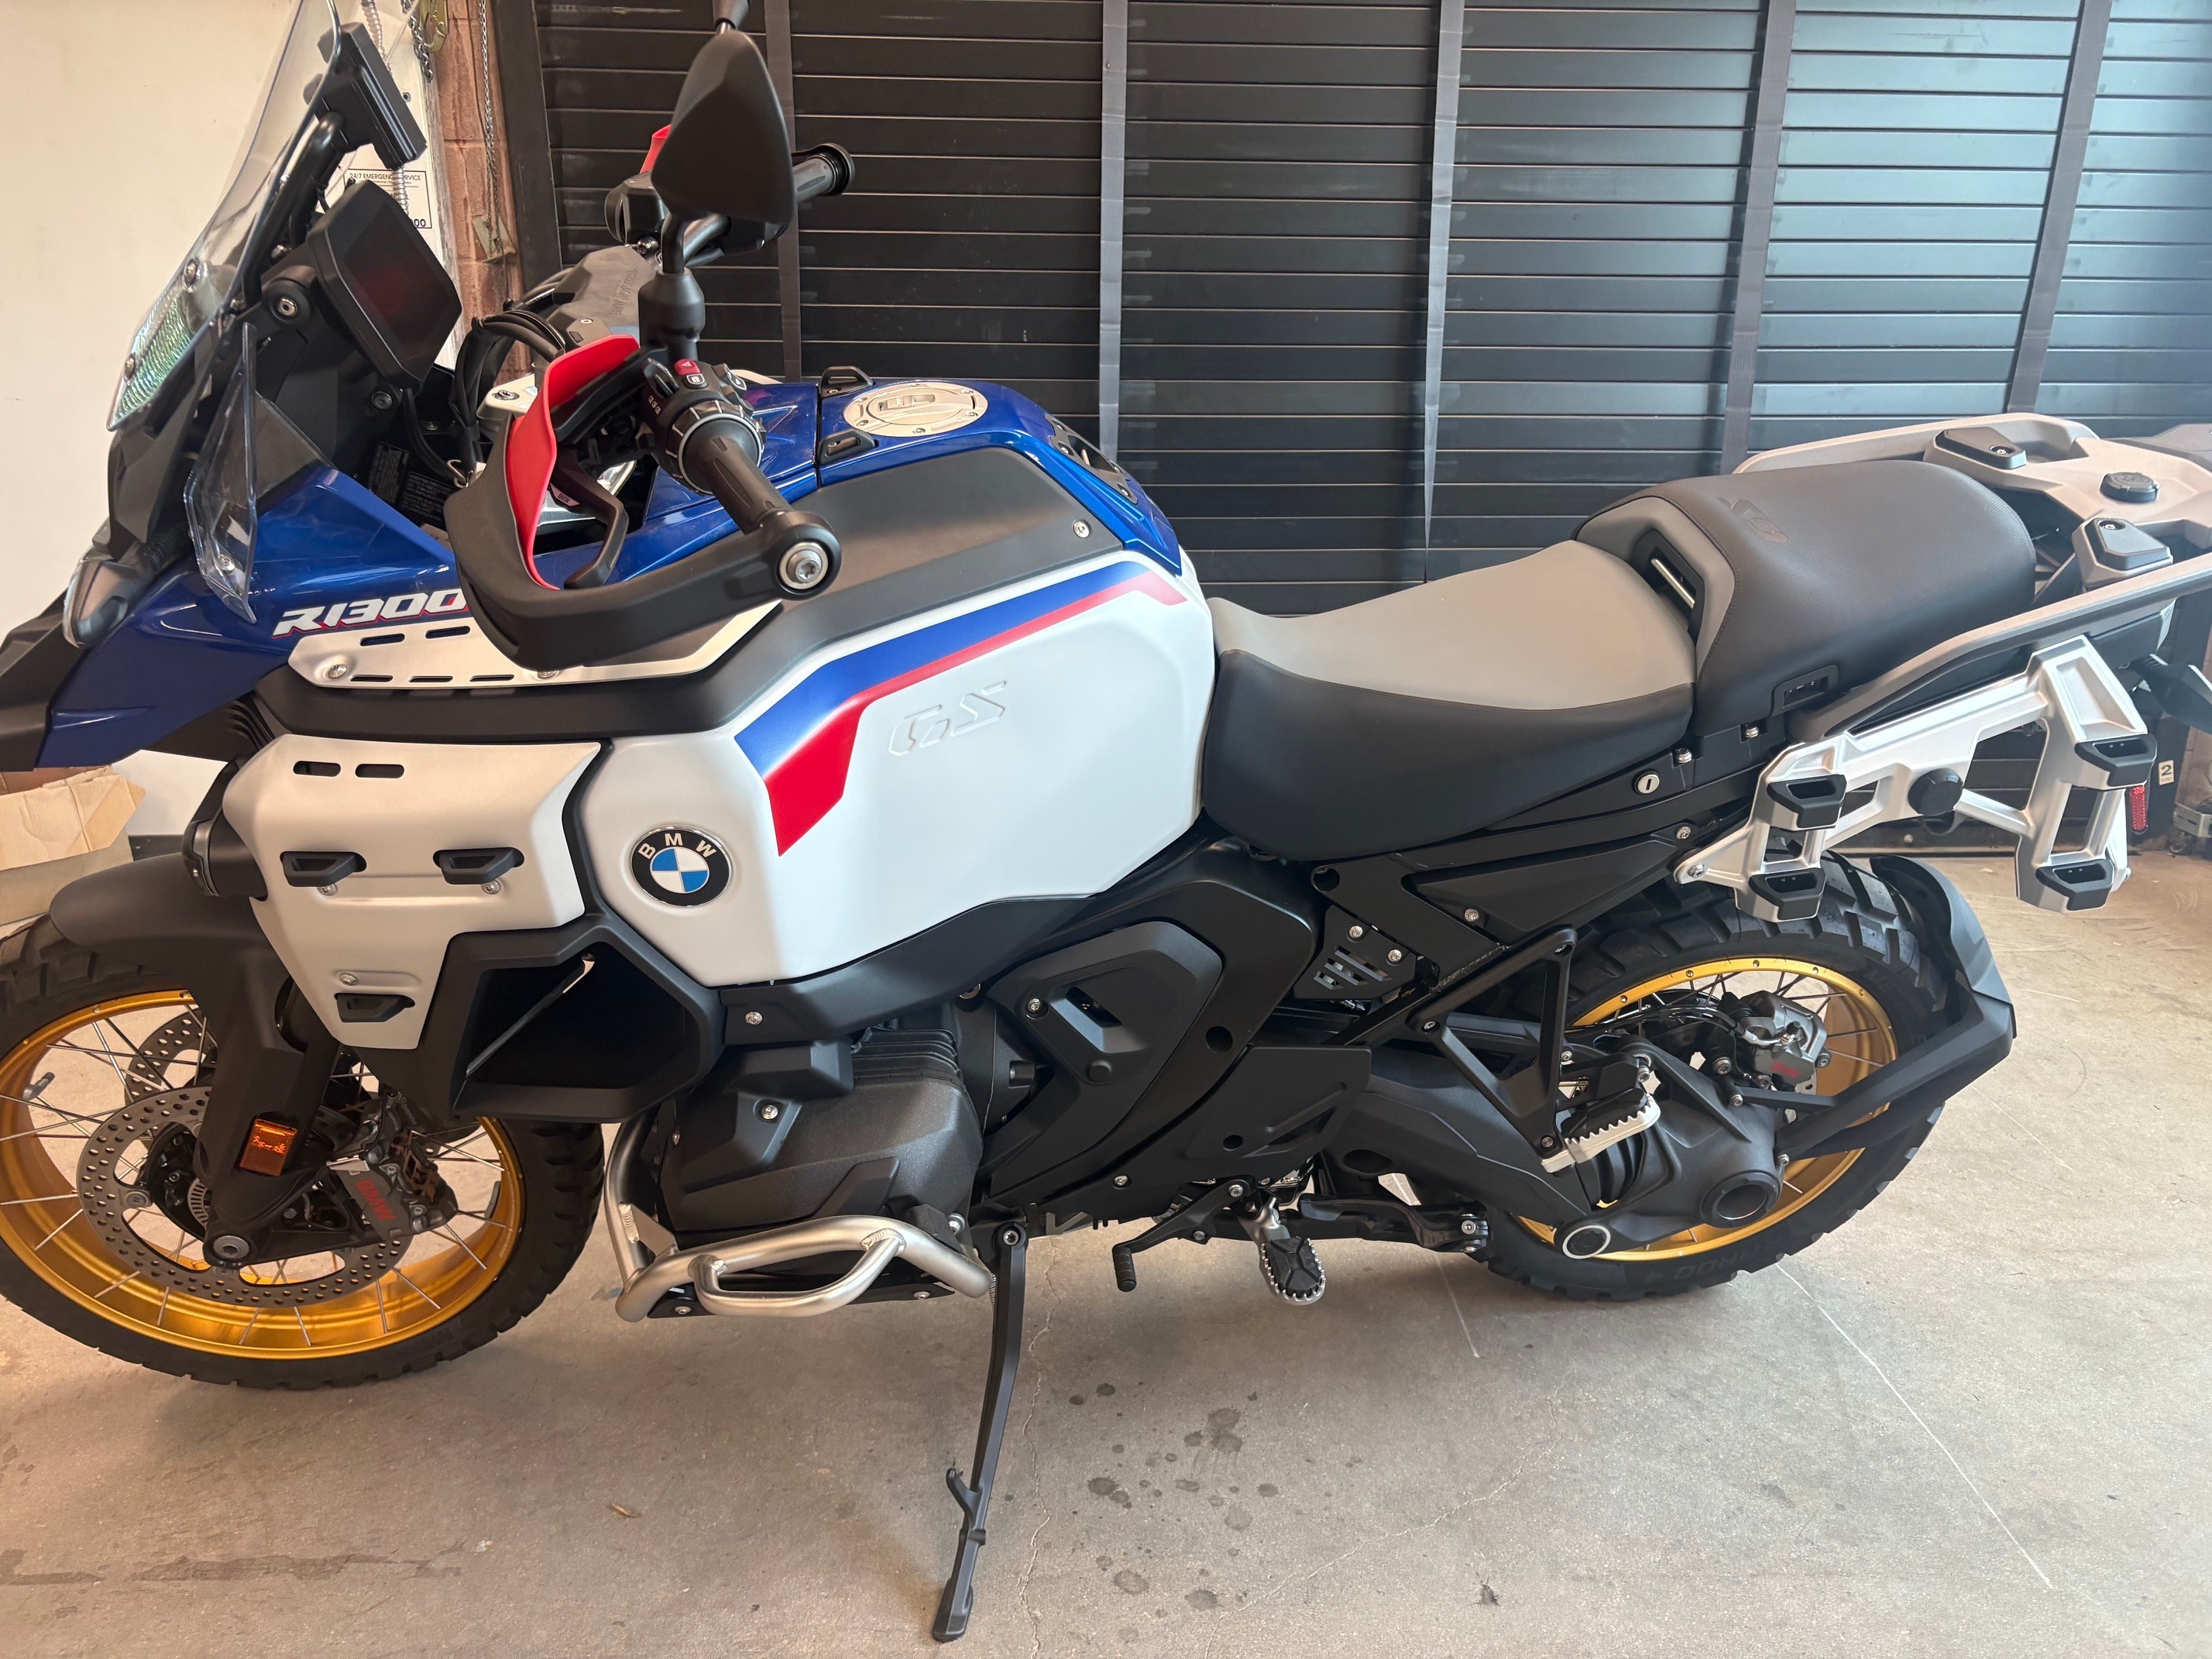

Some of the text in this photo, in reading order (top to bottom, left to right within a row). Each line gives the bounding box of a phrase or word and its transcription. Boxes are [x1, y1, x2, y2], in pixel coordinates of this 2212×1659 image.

[888, 681, 1006, 756] GS
[2161, 764, 2172, 777] 2
[638, 833, 717, 860] BMW
[356, 1179, 397, 1220] BMW
